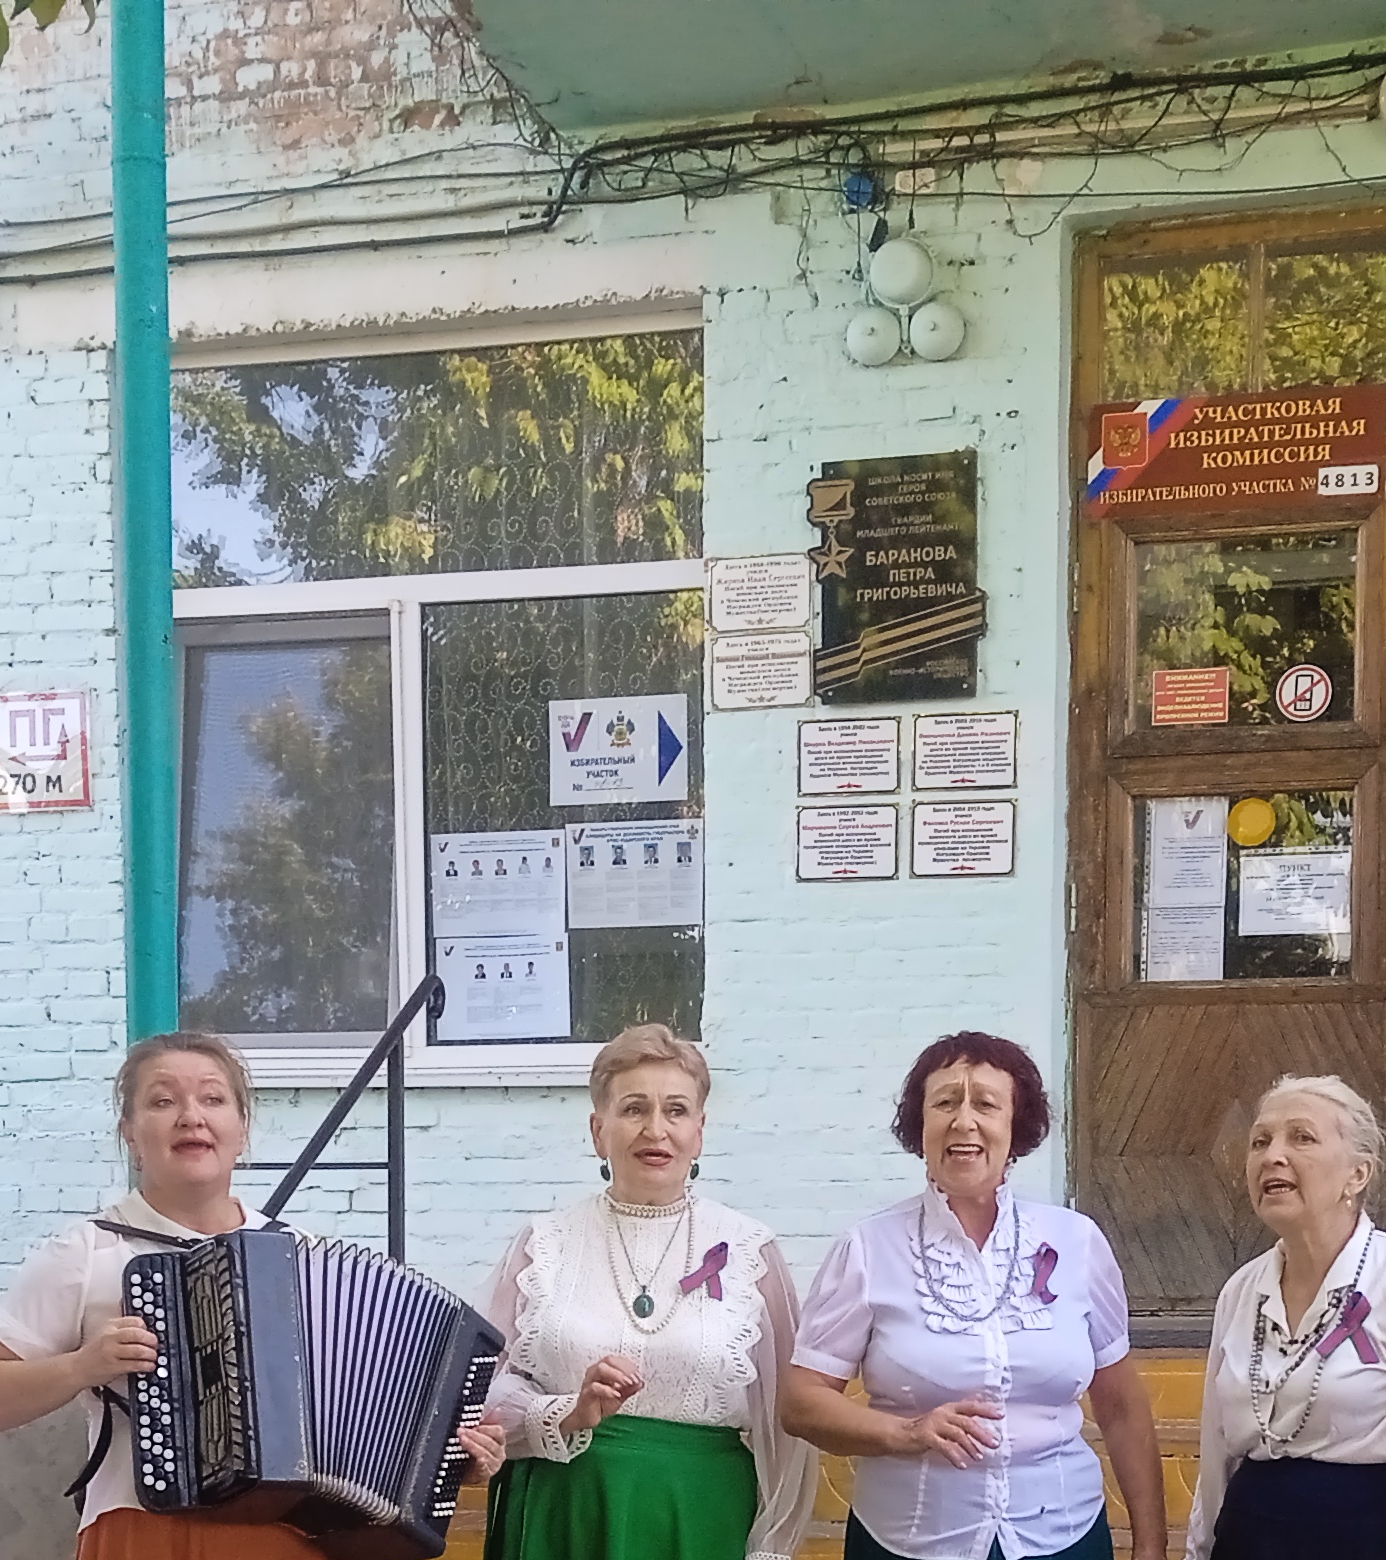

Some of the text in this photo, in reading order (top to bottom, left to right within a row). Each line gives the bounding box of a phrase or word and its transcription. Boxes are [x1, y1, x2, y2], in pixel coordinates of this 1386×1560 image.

[1194, 397, 1342, 424] УЧАСТКОВАЯ
[1170, 419, 1366, 448] ИЗБИРАТЕЛЬНАЯ
[1202, 444, 1331, 469] КОМИССИЯ
[869, 475, 901, 485] ШКОЛА
[904, 472, 932, 481] НОСИТ
[898, 483, 926, 493] ГЕРОЯ
[1099, 482, 1226, 504] ИЗБИРАТЕЛЬНОГО
[1232, 478, 1294, 496] УЧАСТКА
[1320, 471, 1375, 488] 4813
[866, 494, 923, 506] СОВЕТСКОГО
[856, 527, 906, 538] МЛАДШЕГО
[866, 546, 957, 565] БАРАНОВА
[889, 567, 935, 582] ПЕТРА
[856, 582, 966, 602] ГРИГОРЬЕВИЧА
[570, 754, 635, 767] ИЗБИРАТЕЛЬНЫЙ
[586, 769, 619, 779] УЧАСТОК
